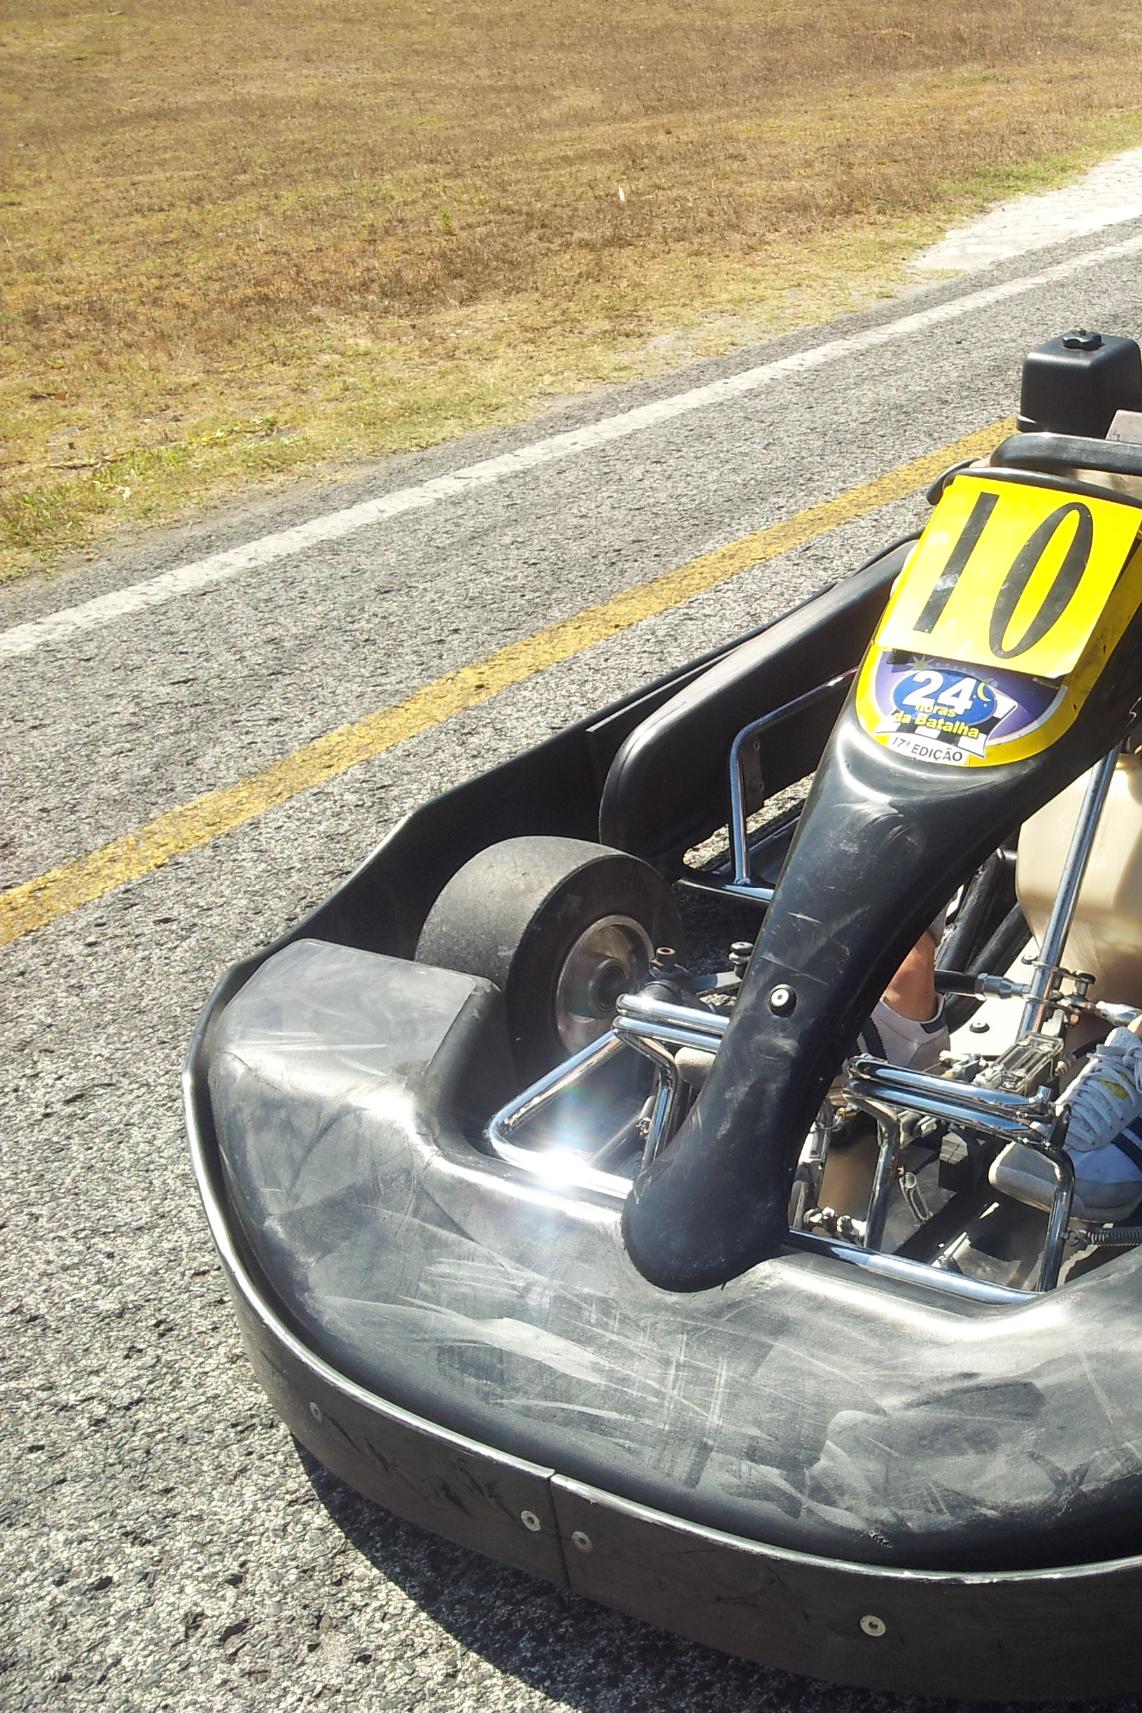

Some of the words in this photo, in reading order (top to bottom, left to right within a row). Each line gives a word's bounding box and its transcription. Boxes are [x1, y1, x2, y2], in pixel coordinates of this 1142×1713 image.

[912, 491, 1094, 659] 10
[902, 670, 977, 714] 24
[893, 711, 911, 724] da
[914, 713, 980, 739] Batalha
[911, 744, 963, 762] EDIÇÃO
